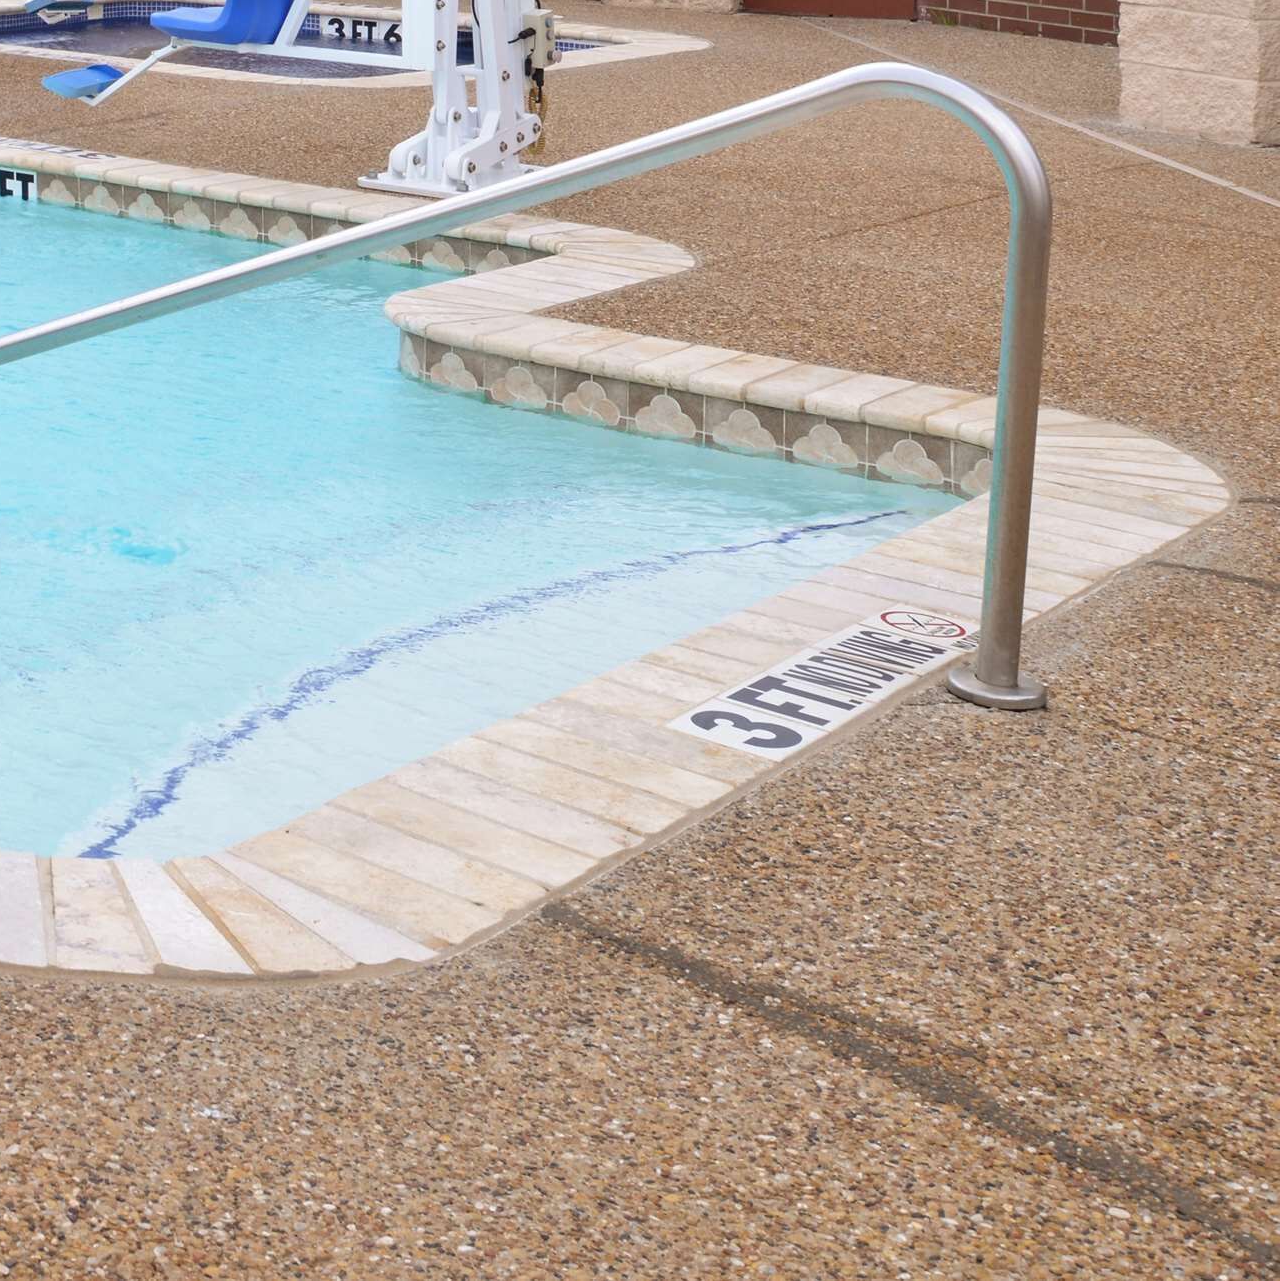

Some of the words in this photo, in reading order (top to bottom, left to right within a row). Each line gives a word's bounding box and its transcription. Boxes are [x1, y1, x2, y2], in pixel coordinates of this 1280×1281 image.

[328, 17, 346, 38] 3
[352, 20, 377, 41] FT
[0, 169, 34, 201] FT
[690, 710, 802, 749] 3
[810, 630, 947, 682] DIVING
